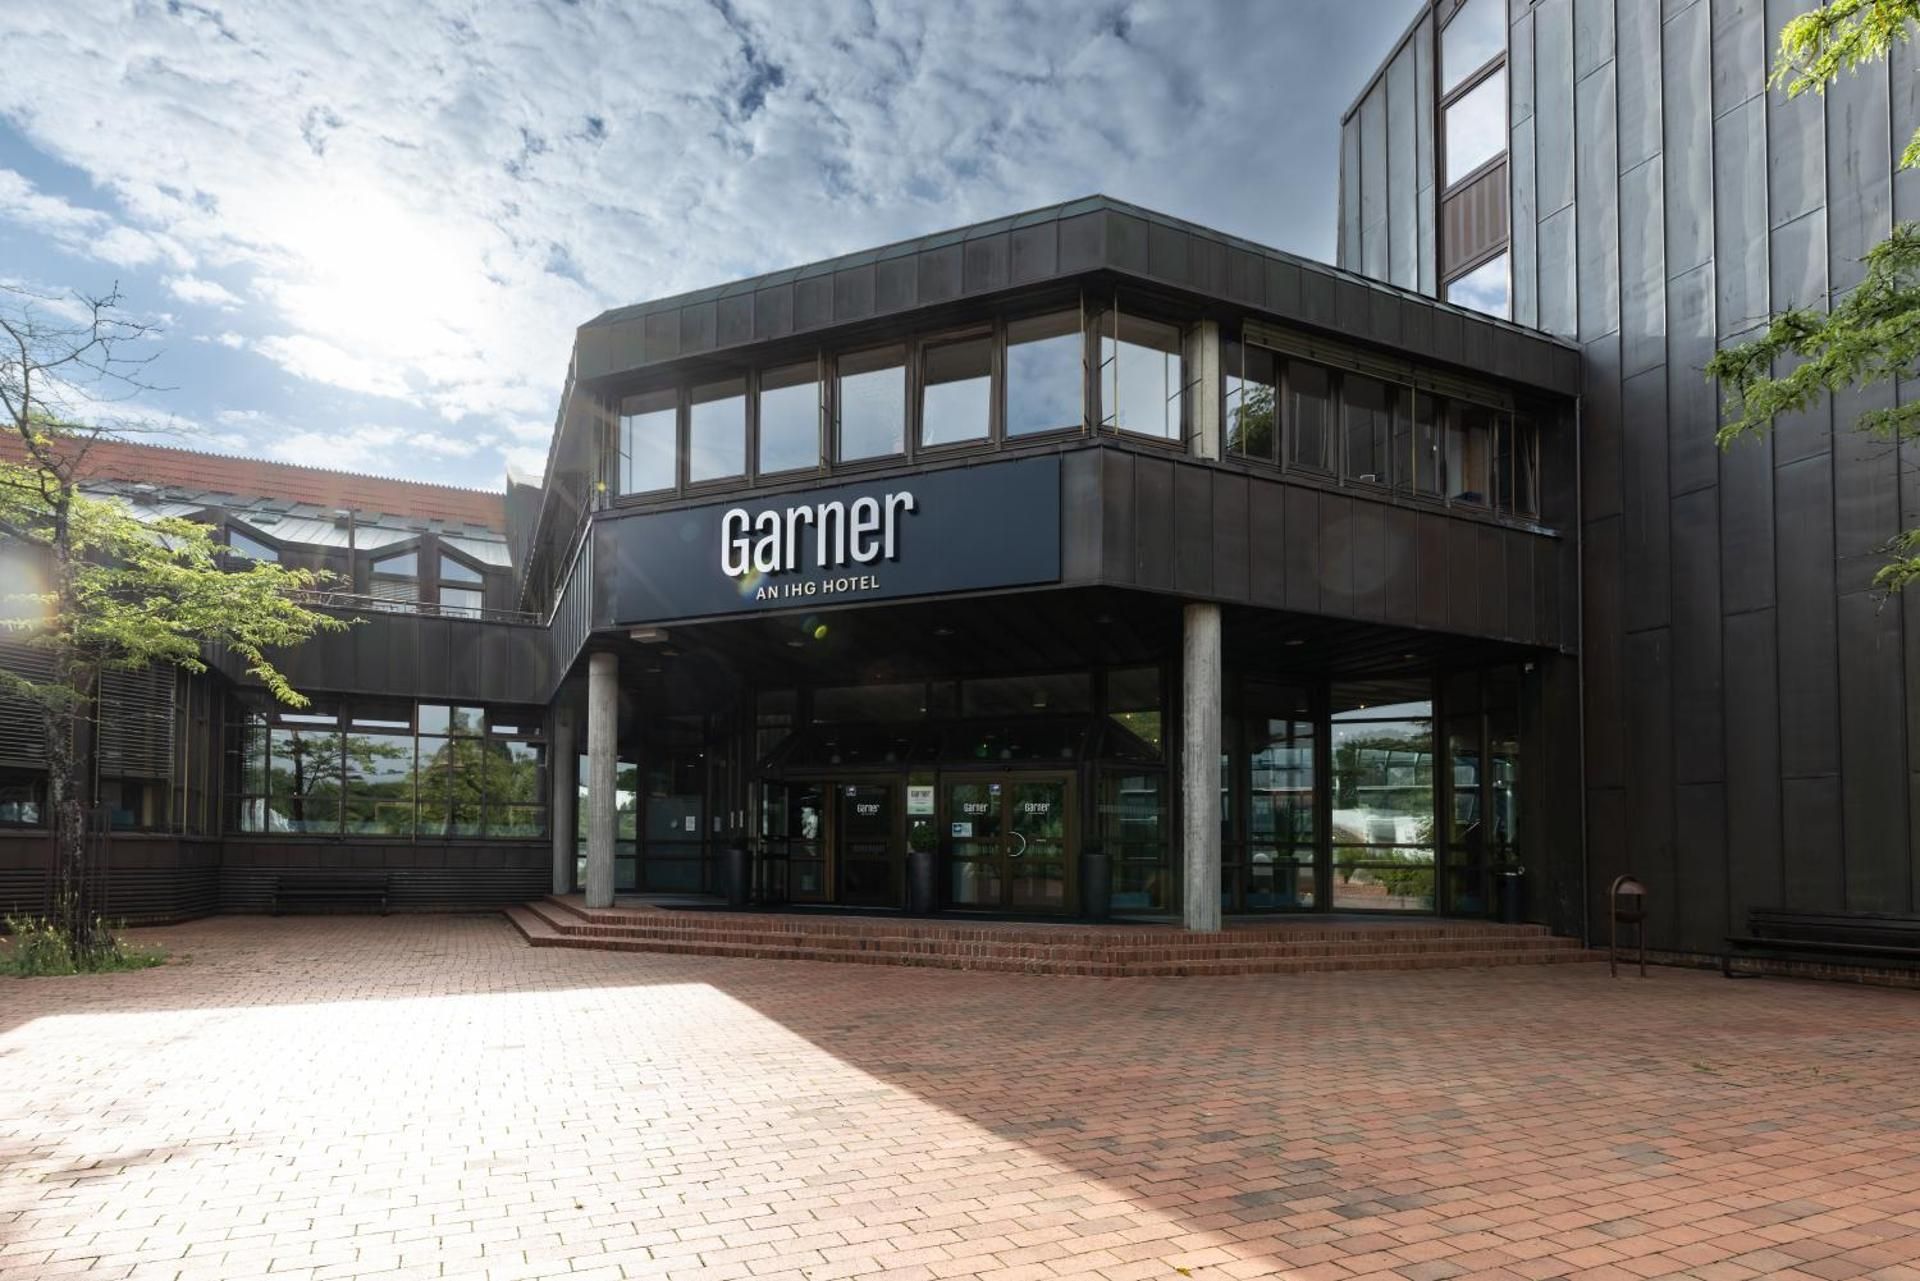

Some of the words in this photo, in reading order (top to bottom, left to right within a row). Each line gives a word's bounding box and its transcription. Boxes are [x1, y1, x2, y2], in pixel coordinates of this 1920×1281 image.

[721, 491, 914, 577] Garner
[756, 584, 778, 600] AN
[785, 581, 816, 598] IHG
[823, 575, 880, 594] HOTEL
